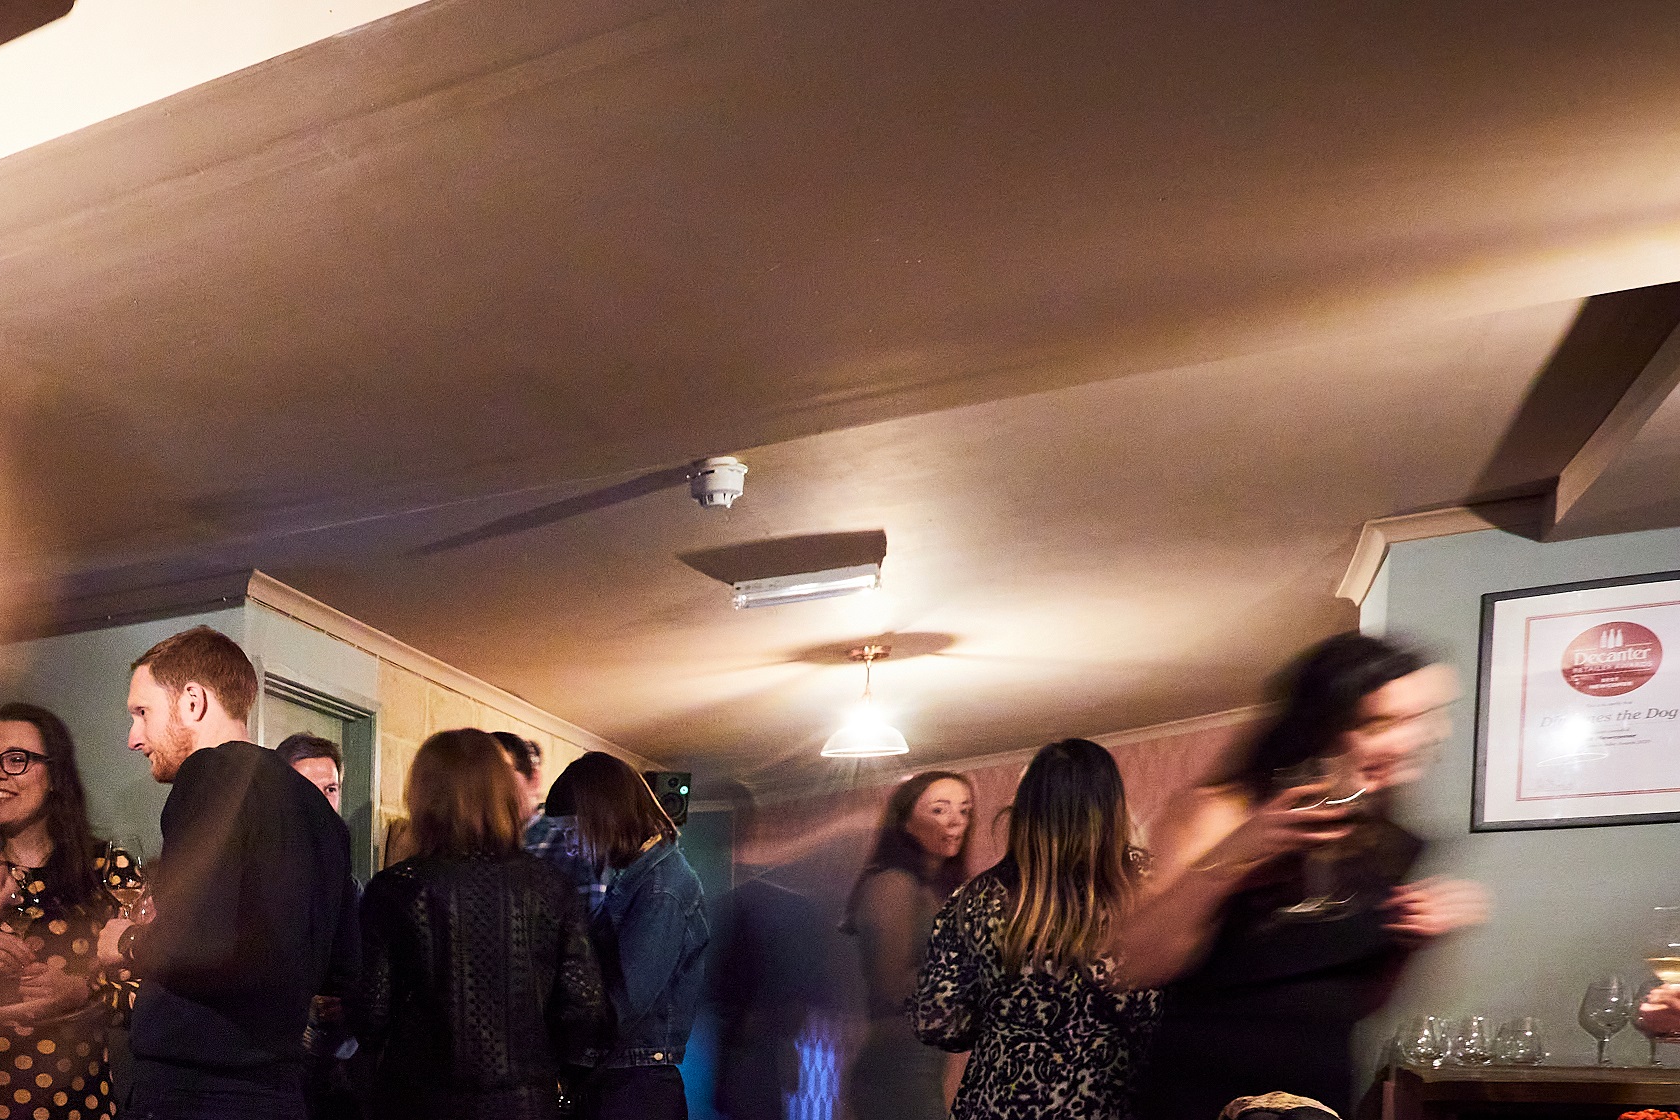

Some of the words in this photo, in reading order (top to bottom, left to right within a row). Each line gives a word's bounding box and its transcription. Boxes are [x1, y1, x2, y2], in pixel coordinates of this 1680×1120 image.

[1573, 648, 1651, 665] Decanter
[1616, 710, 1641, 721] the
[1645, 707, 1679, 720] Dog
